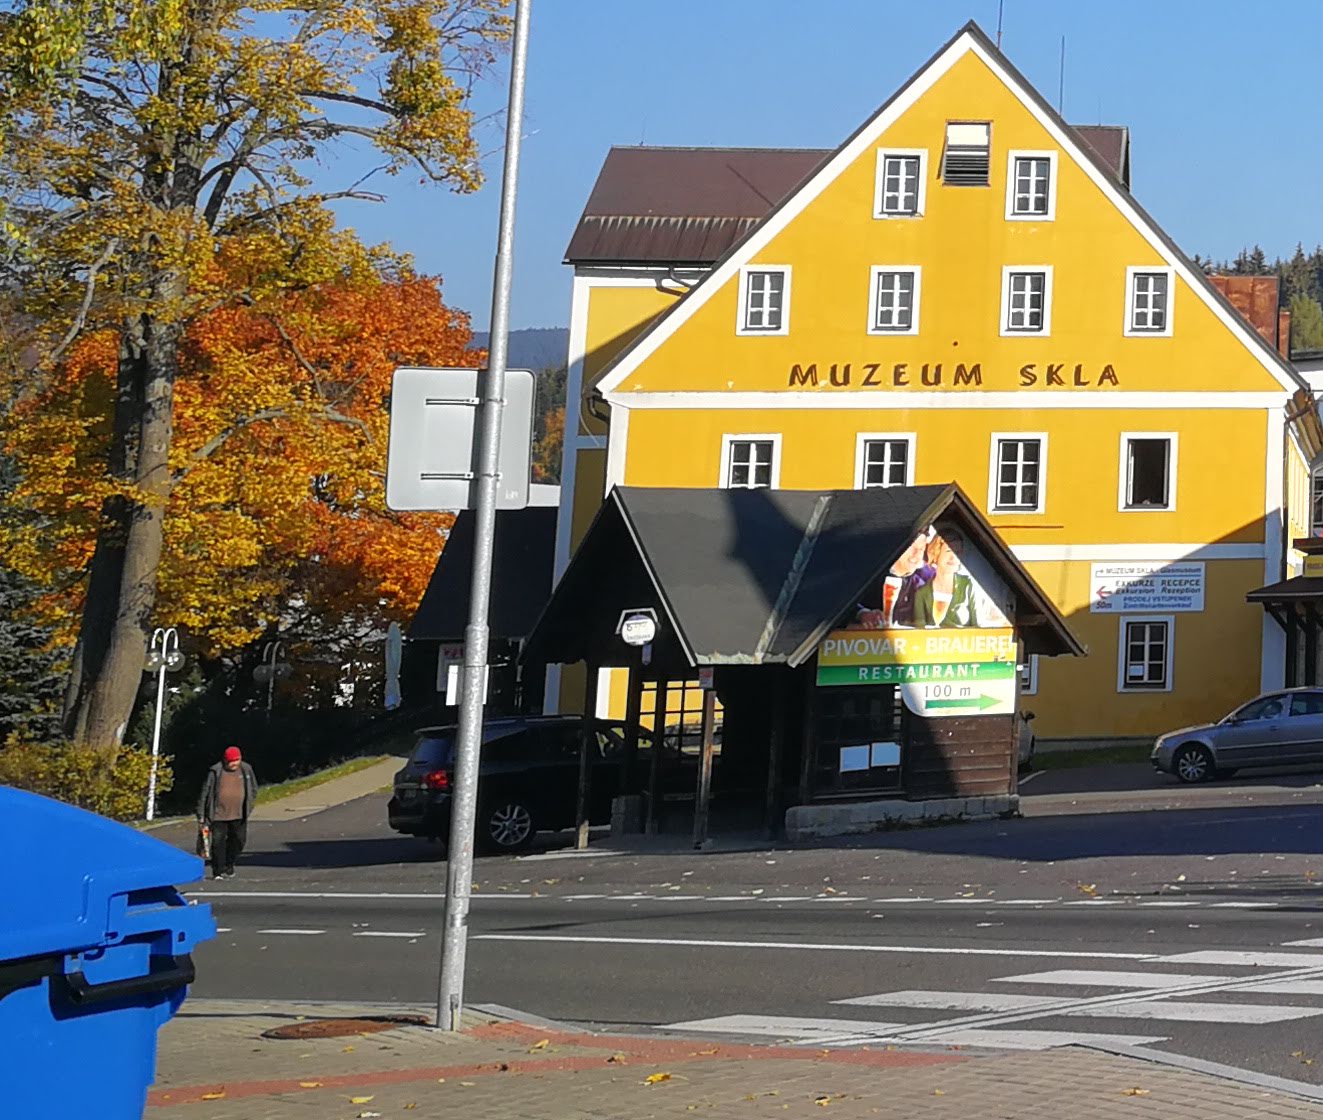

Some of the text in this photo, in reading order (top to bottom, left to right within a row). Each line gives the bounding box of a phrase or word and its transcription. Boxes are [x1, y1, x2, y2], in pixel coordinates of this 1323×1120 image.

[788, 363, 1120, 387] MUZEUM SKLA
[1161, 578, 1201, 587] RECEPCE
[823, 638, 907, 657] PIVOVAR
[926, 635, 1013, 655] BRAUEREI
[859, 664, 981, 680] RESTAURANT
[924, 685, 971, 698] 100 m
